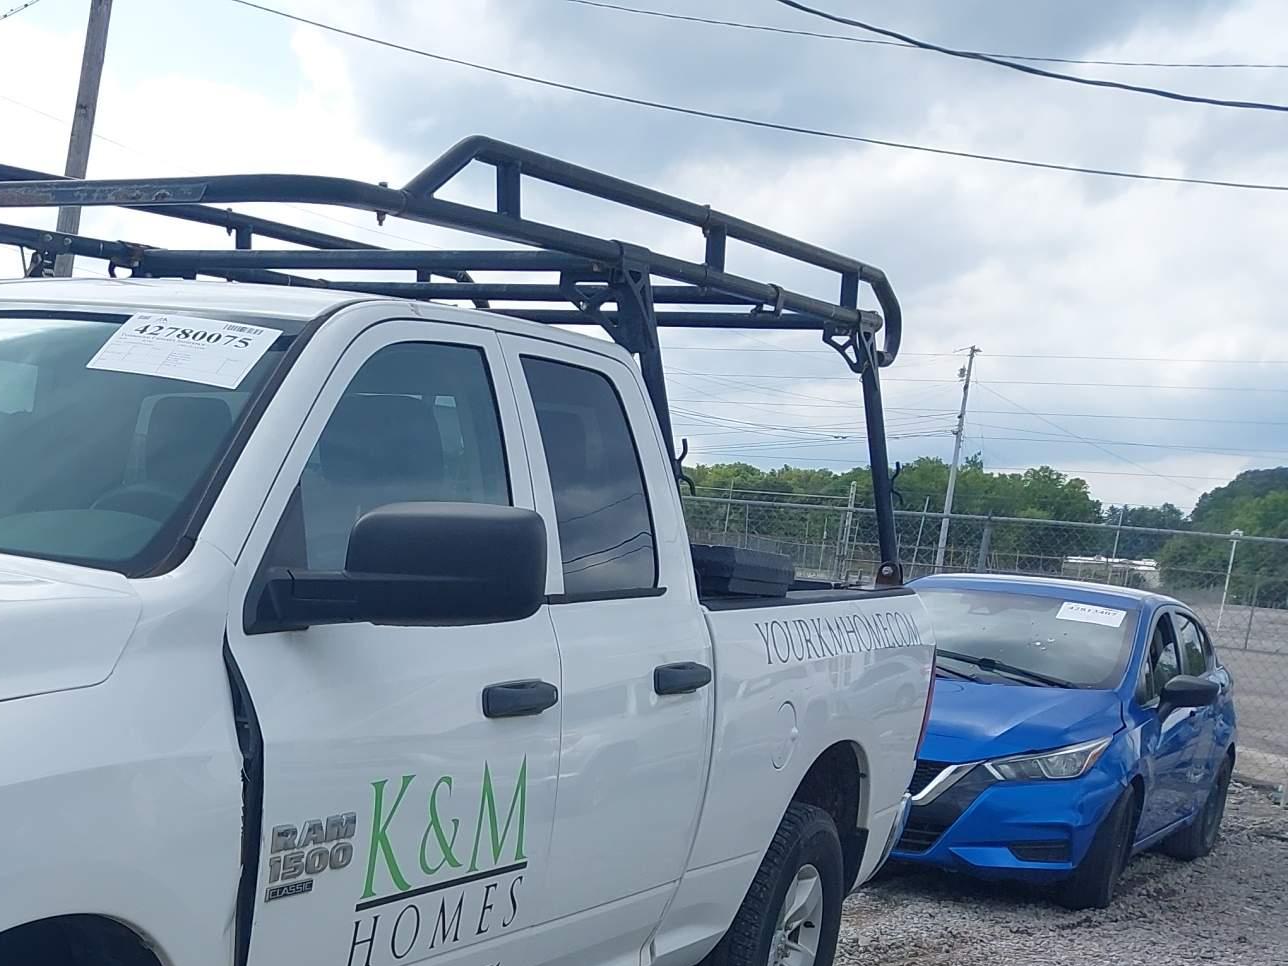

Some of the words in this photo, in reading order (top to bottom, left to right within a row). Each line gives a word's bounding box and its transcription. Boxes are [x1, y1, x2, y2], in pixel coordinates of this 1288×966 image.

[134, 323, 253, 350] 42780075
[270, 811, 357, 854] RAM
[360, 752, 528, 900] K&M
[268, 842, 354, 884] 1500
[268, 880, 313, 900] CLASSIC
